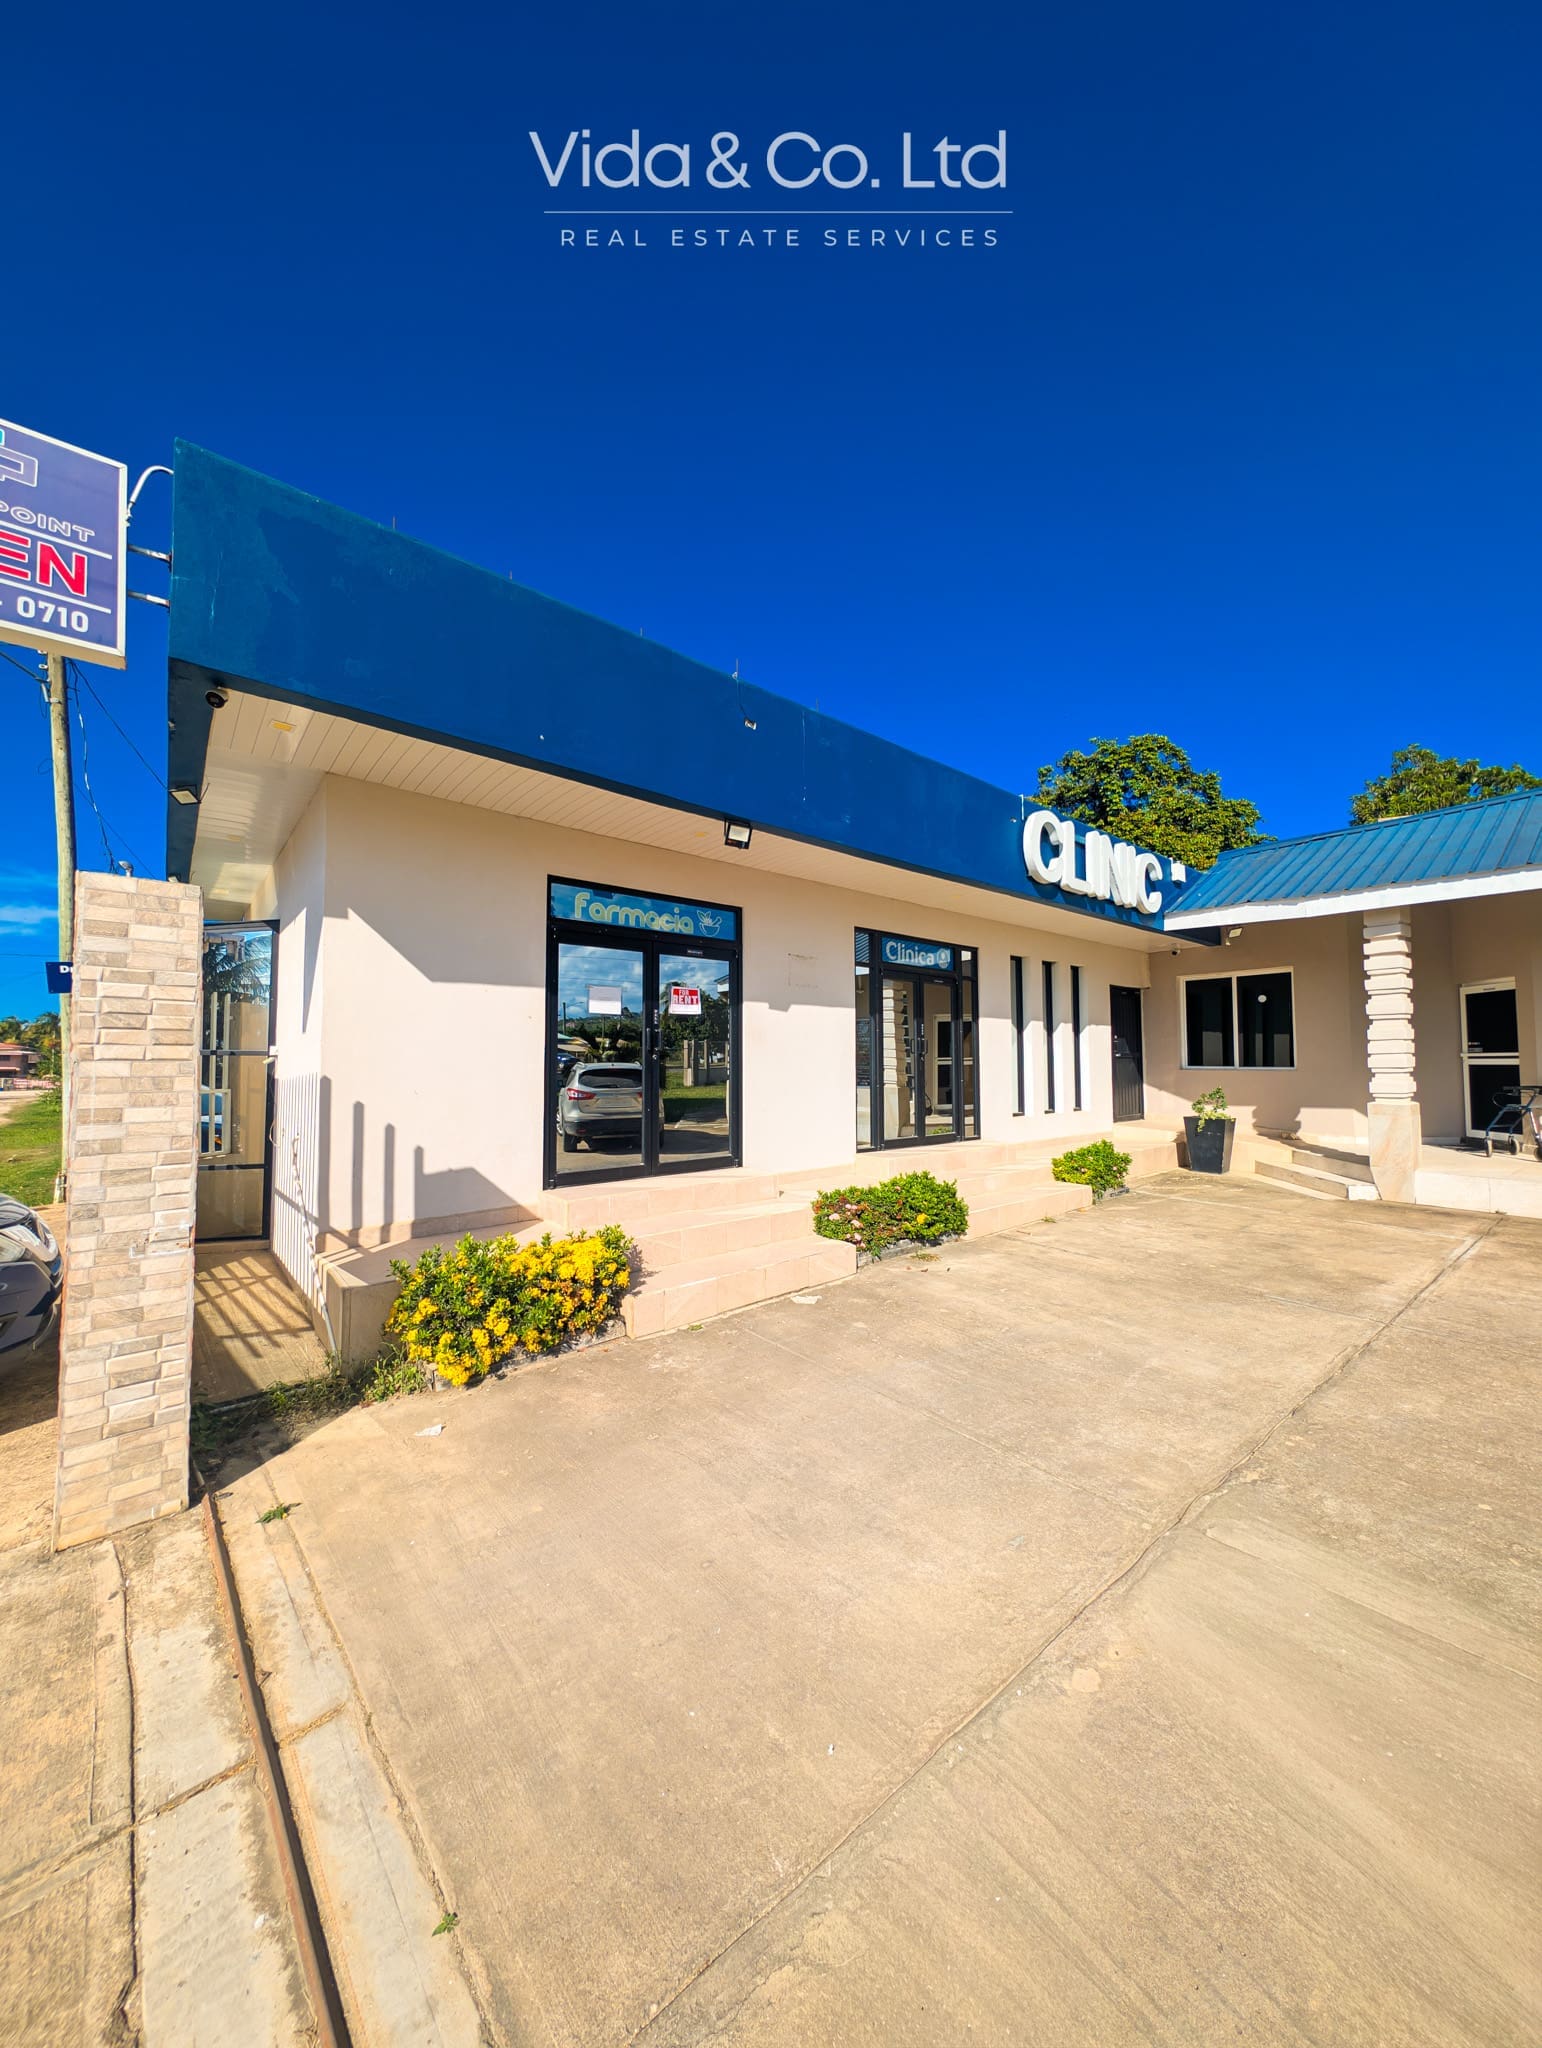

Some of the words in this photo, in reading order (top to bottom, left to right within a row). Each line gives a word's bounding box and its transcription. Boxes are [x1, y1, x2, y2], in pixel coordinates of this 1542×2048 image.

[16, 596, 89, 633] 0710
[1023, 810, 1163, 914] CLINIC
[885, 941, 935, 966] Clinica
[672, 994, 698, 1005] RENT
